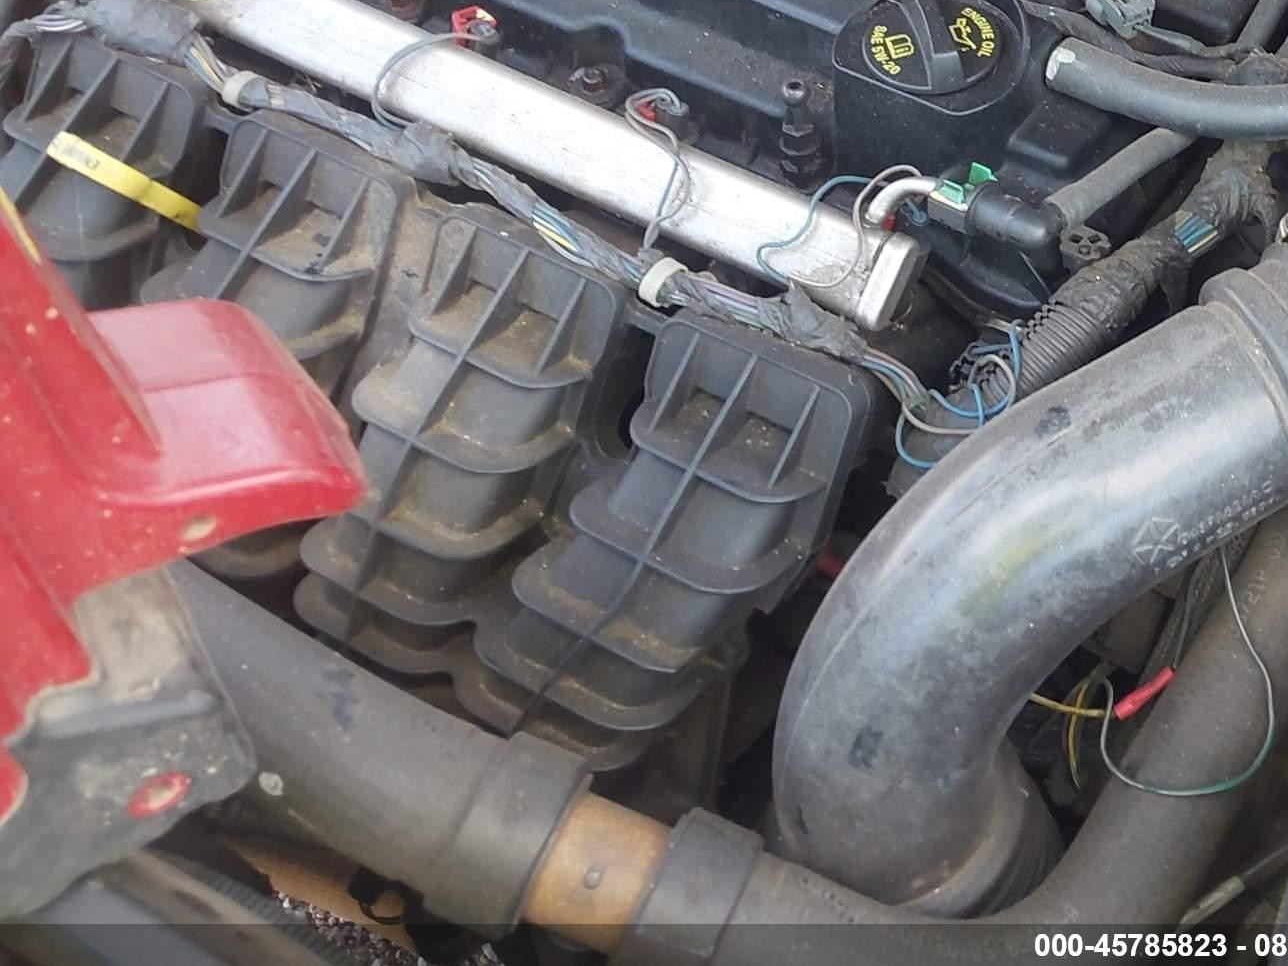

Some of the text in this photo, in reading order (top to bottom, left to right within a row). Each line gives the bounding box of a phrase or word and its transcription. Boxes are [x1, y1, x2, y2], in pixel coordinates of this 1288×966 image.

[961, 7, 995, 58] ENGINE OIL
[871, 46, 901, 75] 5W-20
